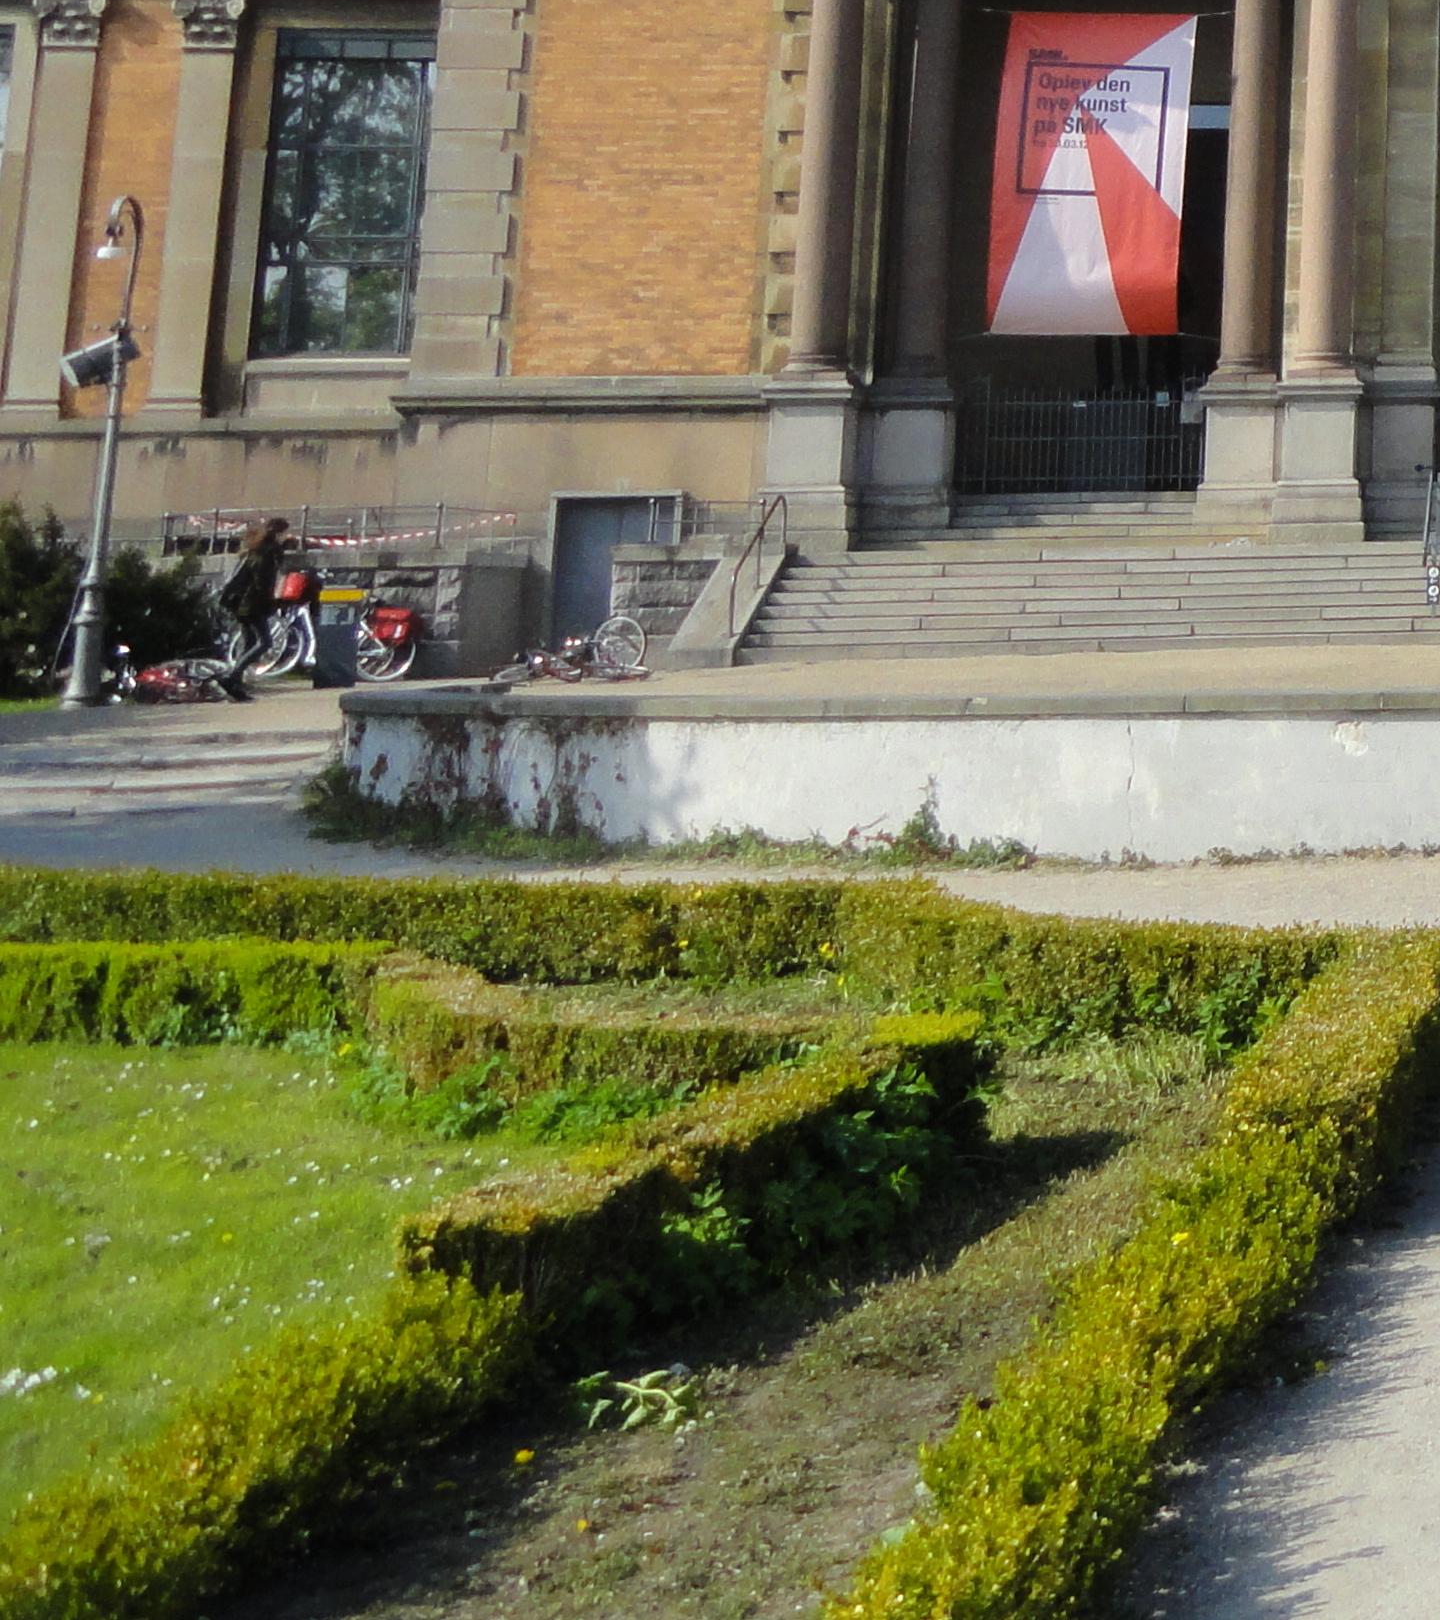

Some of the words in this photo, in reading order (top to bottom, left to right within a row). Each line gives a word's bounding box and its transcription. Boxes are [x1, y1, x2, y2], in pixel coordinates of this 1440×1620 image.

[1039, 72, 1093, 92] Oplev
[1096, 75, 1131, 93] den
[1036, 96, 1070, 113] nye
[1074, 95, 1128, 113] kunst
[1063, 116, 1108, 135] SMK
